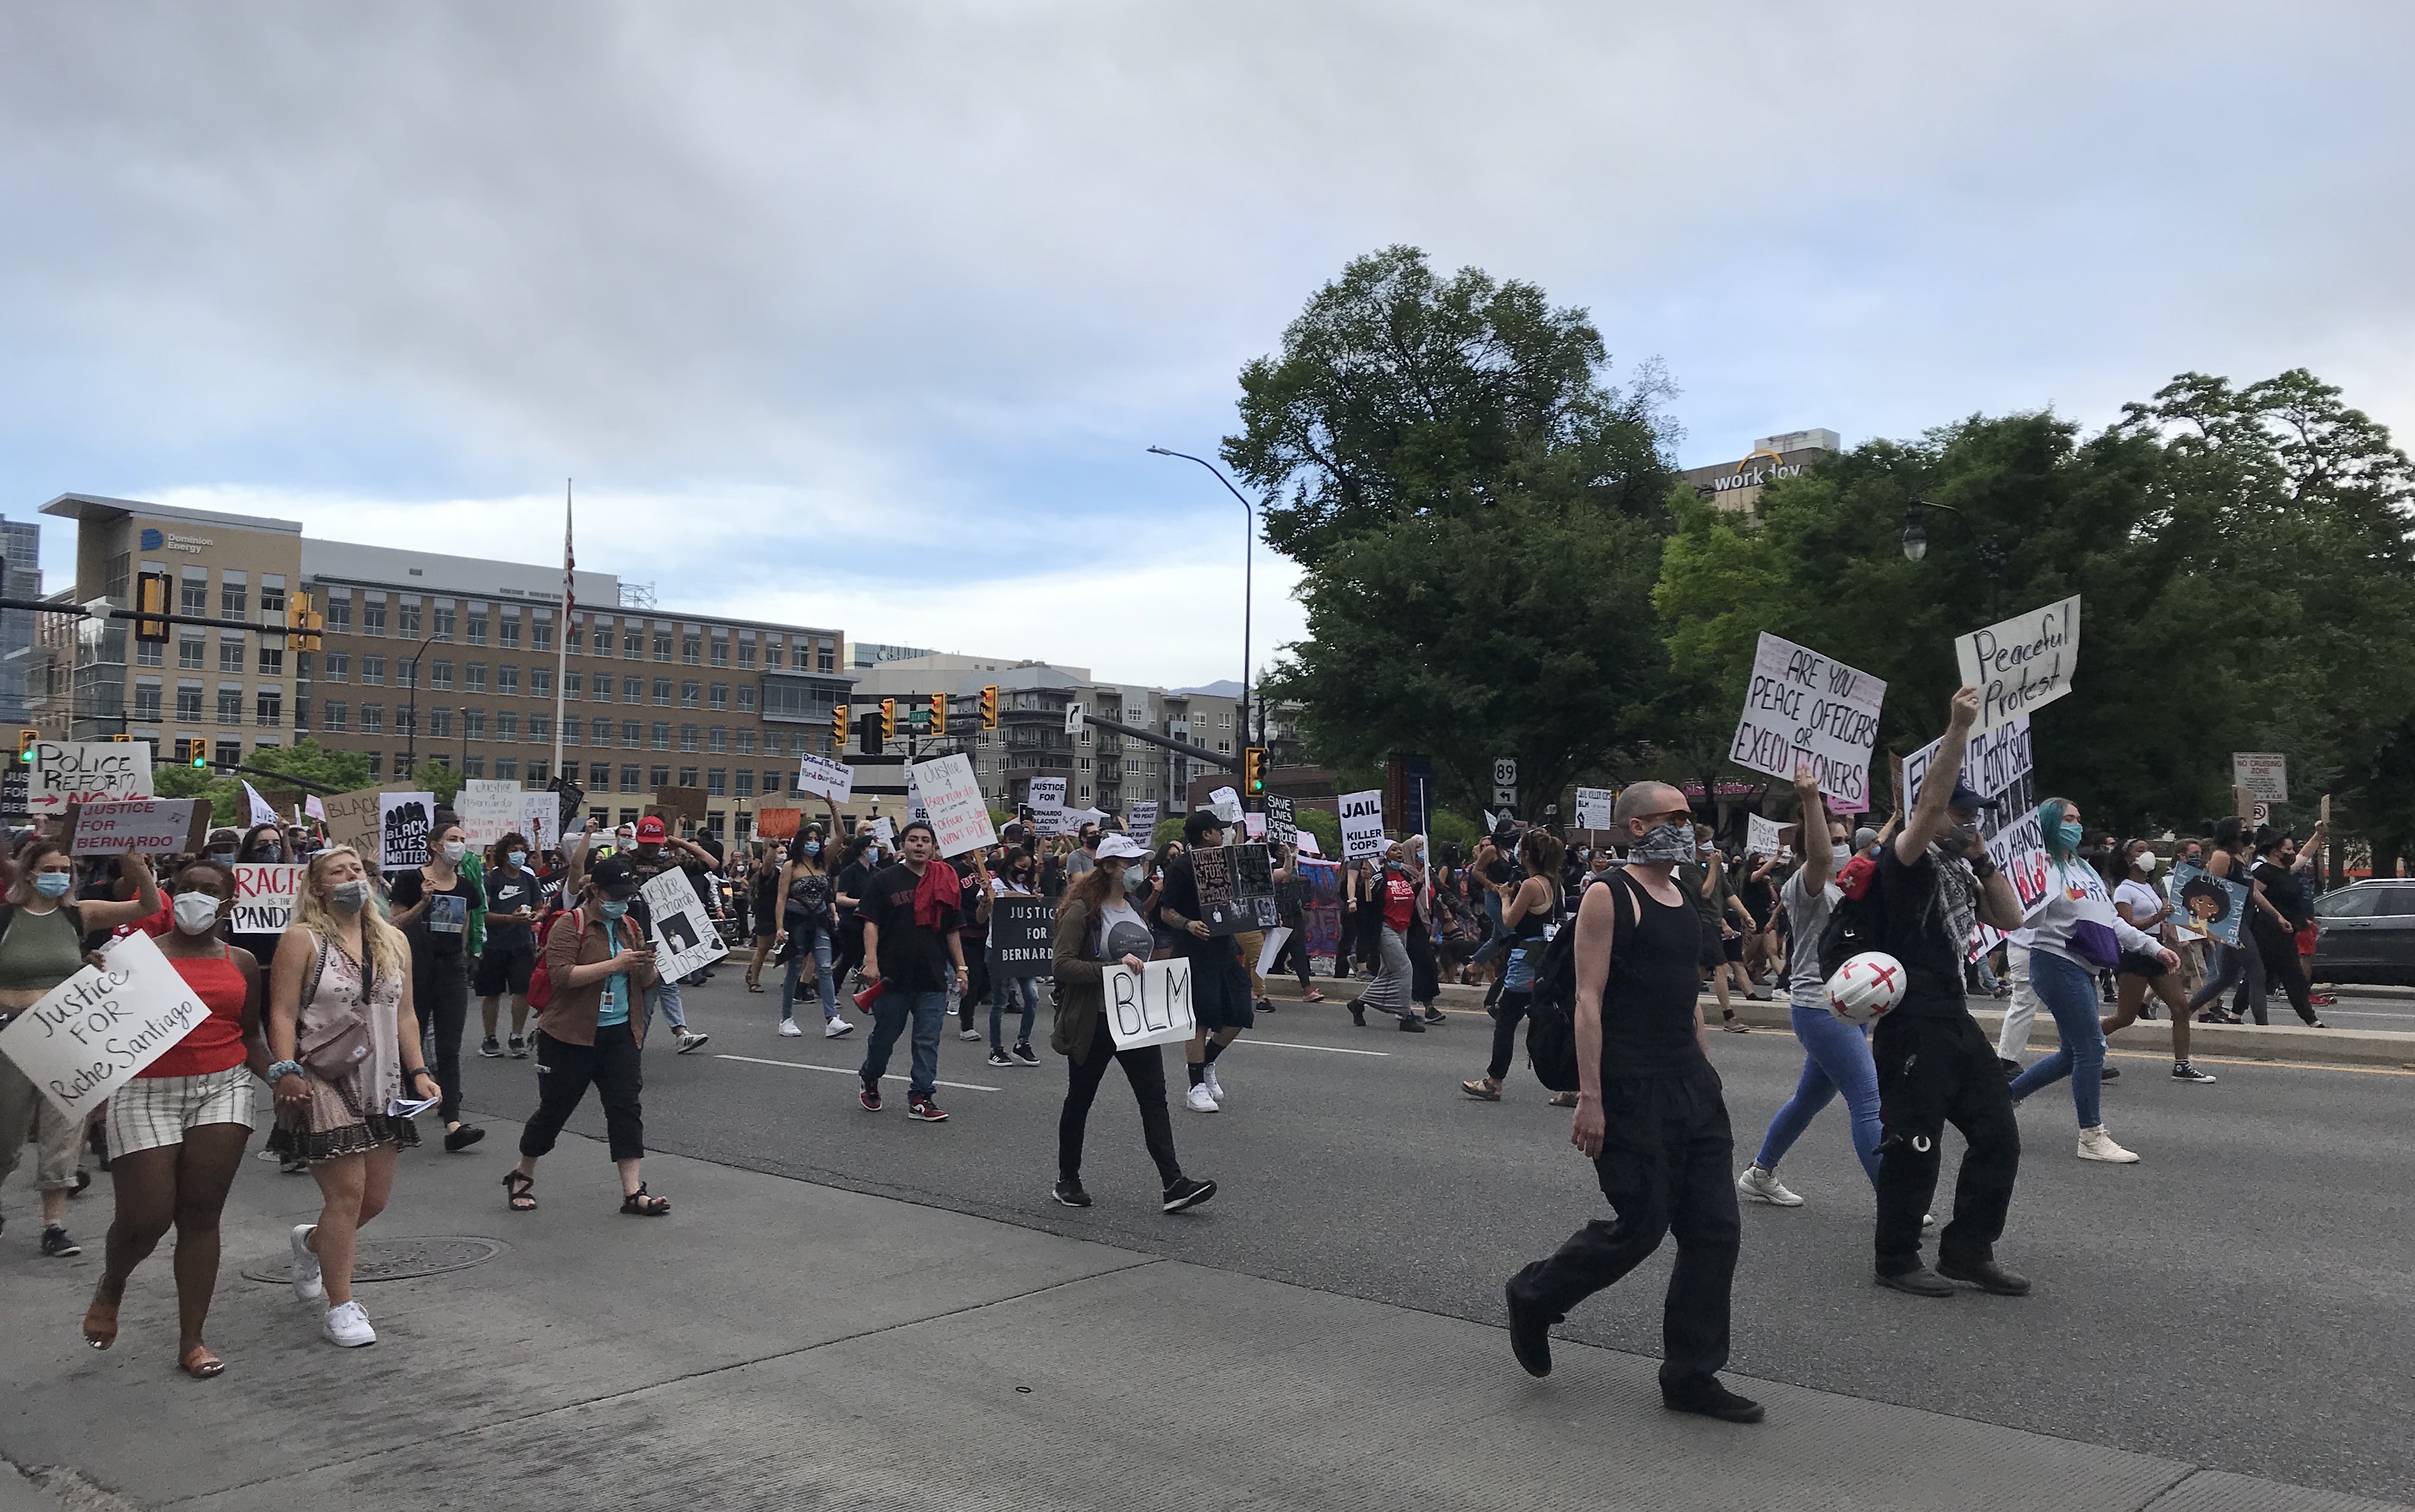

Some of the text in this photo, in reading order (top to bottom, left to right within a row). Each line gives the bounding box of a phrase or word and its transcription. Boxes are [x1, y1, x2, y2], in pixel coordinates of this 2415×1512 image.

[168, 532, 213, 546] Dominion
[168, 541, 202, 553] Energy
[1973, 604, 2070, 685] Peaceful
[1785, 649, 1824, 690] ARE
[1828, 664, 1857, 698] YOU
[1983, 652, 2060, 728] Protest
[1750, 675, 1805, 721] PEACE
[1809, 698, 1879, 749] OFFICERS
[1794, 727, 1814, 748] OR
[36, 743, 131, 773] POLICE
[2010, 728, 2034, 775] SHIT
[43, 769, 136, 791] REFORM
[924, 760, 962, 784] Justice
[1496, 764, 1514, 779] 89
[945, 778, 953, 790] 4
[1031, 782, 1065, 791] JUSTICE
[923, 784, 975, 810] Bernardo
[1038, 793, 1056, 802] FOR
[1267, 795, 1291, 811] SAVE
[1578, 800, 1589, 808] BLM
[83, 802, 156, 816] JUSTICE
[327, 796, 380, 818] BLACK
[1342, 800, 1380, 818] JAIL
[1270, 810, 1293, 823] LIVES
[80, 820, 116, 832] FOR
[386, 820, 428, 840] BLACK
[524, 827, 551, 838] BLCK
[1267, 817, 1297, 834] DEFUND
[76, 835, 174, 849] BERNARDO
[386, 835, 427, 852] LIVES
[939, 829, 965, 846] WANT
[965, 825, 974, 836] TO
[1278, 829, 1298, 844] POLICE
[1347, 829, 1382, 842] KILLER
[2009, 814, 2044, 859] HANDS
[1350, 839, 1378, 851] COPS
[1192, 848, 1225, 865] JUSTICE
[1203, 863, 1224, 880] FOR
[2200, 871, 2233, 893] LIVES
[2173, 866, 2189, 917] BLACK
[267, 897, 276, 906] IS
[1010, 905, 1059, 920] JUSTIC
[2227, 899, 2246, 945] MATTER
[1026, 927, 1048, 940] FOR
[671, 942, 715, 977] LOSKE
[29, 969, 130, 1038] Justice
[1112, 966, 1193, 1036] BLM
[69, 1000, 134, 1045] FOR
[105, 1001, 193, 1069] Santiago
